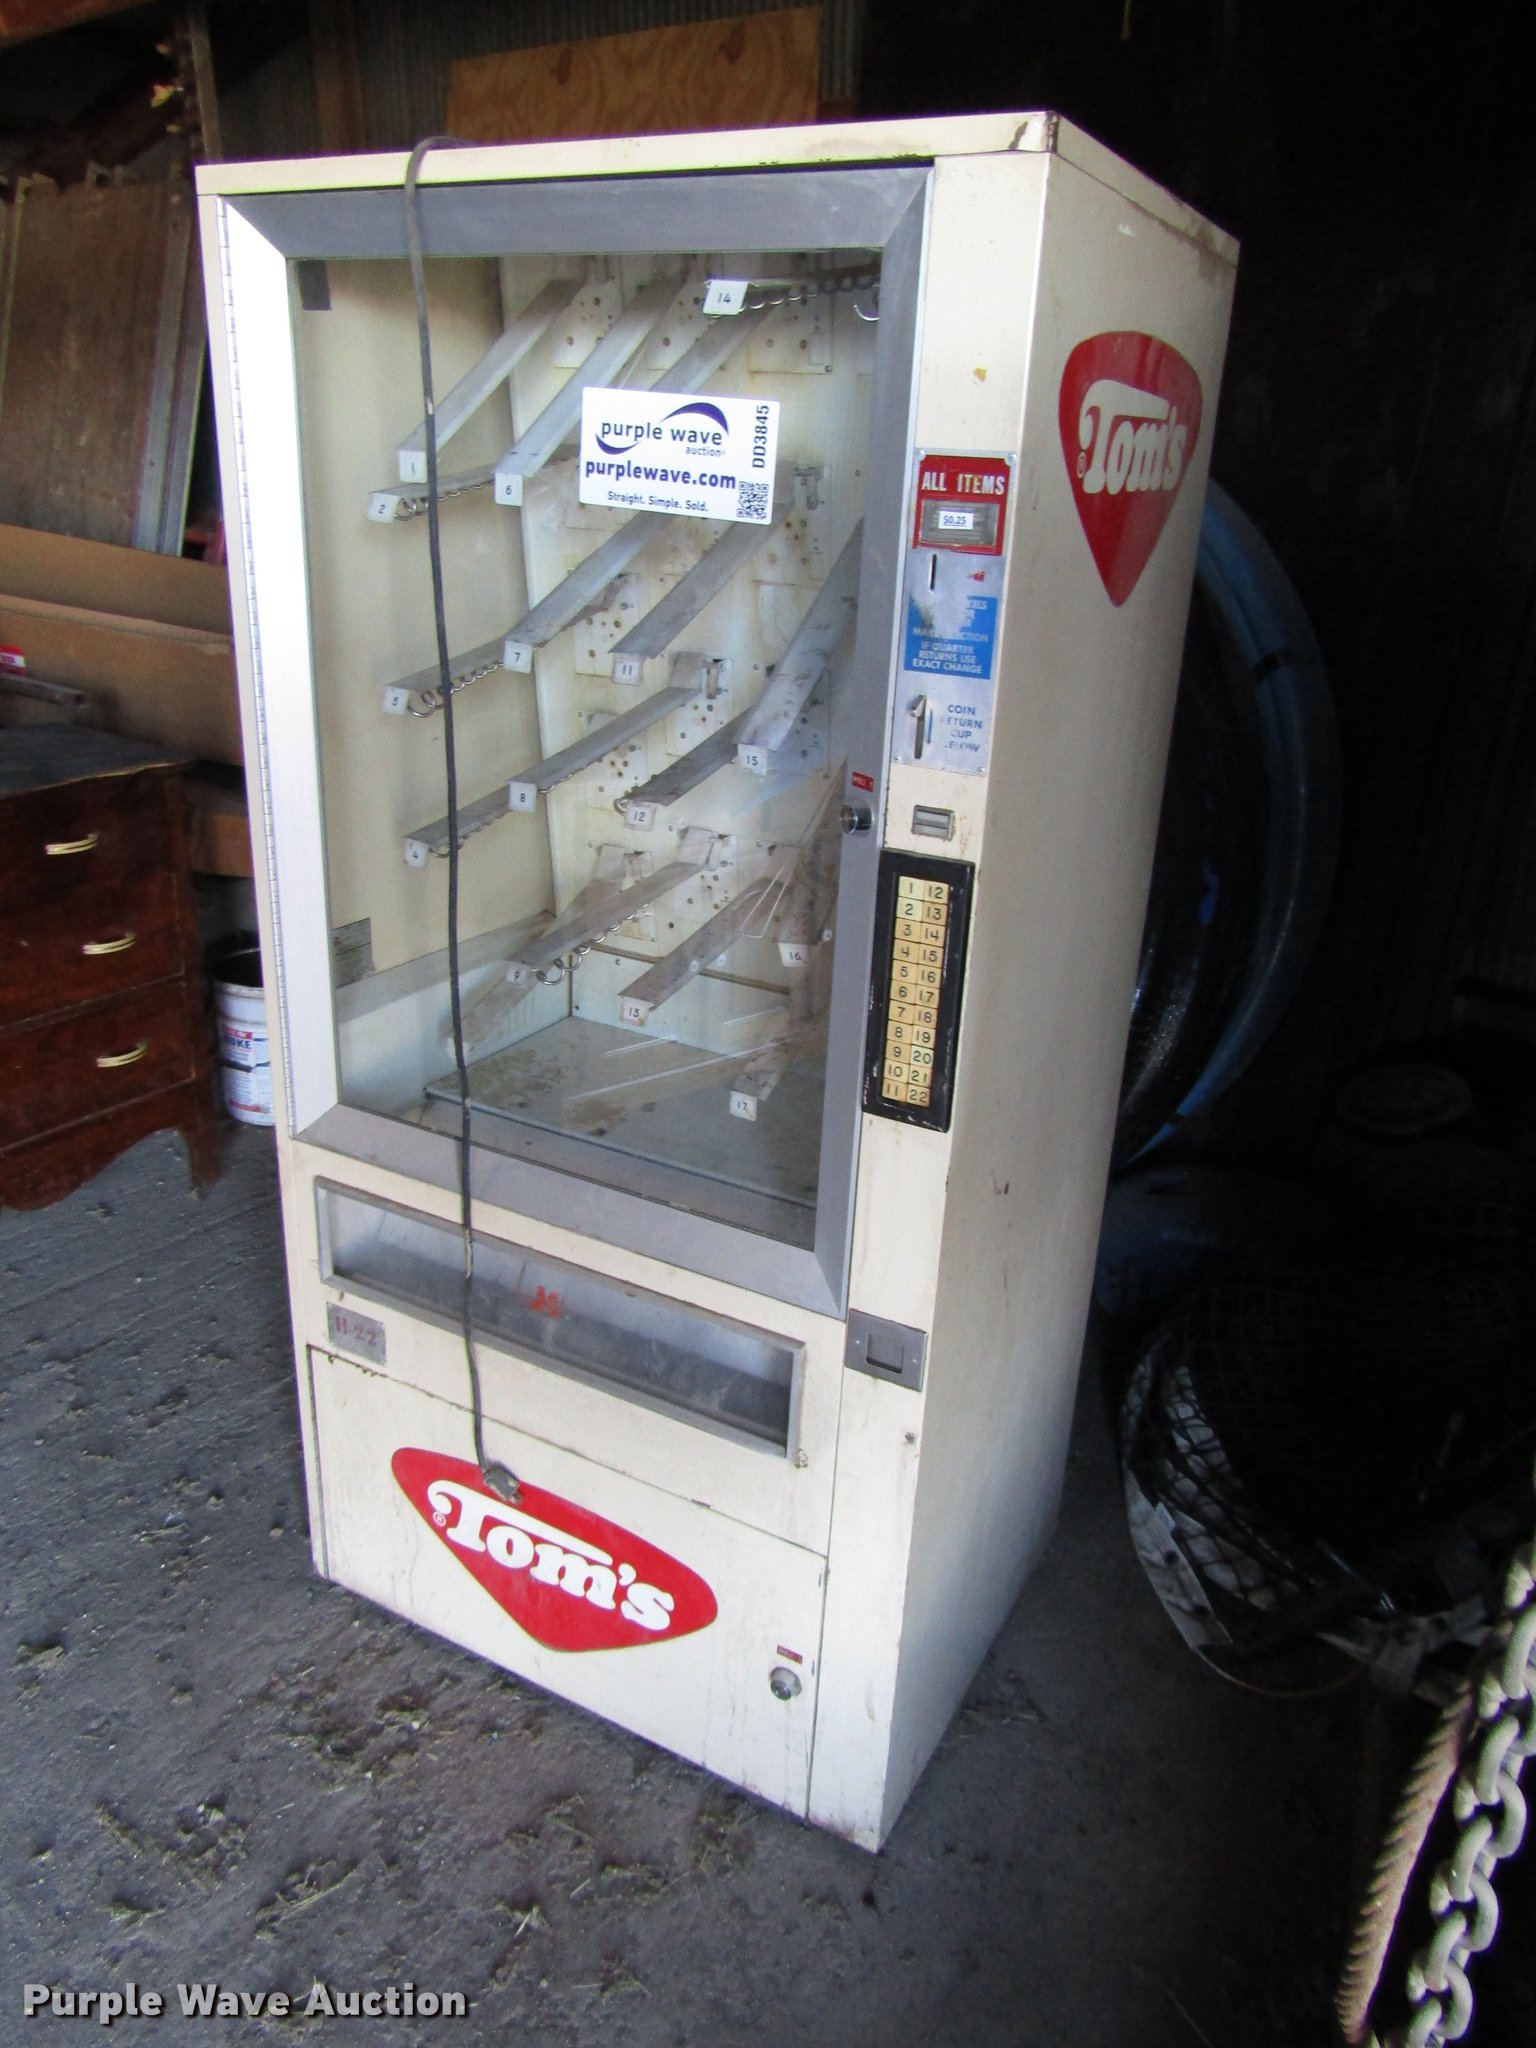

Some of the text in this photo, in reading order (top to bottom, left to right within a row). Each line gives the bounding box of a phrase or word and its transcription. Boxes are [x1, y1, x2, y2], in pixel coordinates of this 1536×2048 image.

[717, 292, 732, 304] 14
[601, 421, 723, 446] purple wave
[752, 405, 770, 469] DD3845
[1079, 378, 1188, 496] Tom's
[585, 460, 737, 490] purplewave.com
[505, 484, 513, 496] 6
[921, 471, 1006, 496] ALL ITEMS
[378, 503, 387, 515] 2
[607, 490, 709, 512] Straight. Simple. Sold.
[943, 514, 967, 526] $0.25
[931, 642, 974, 655] QUARTER
[514, 652, 521, 663] 7
[918, 649, 977, 665] RETURNS USE
[621, 664, 633, 676] 11
[912, 658, 982, 674] EXACT CHANGE
[947, 704, 976, 716] COIN
[946, 717, 983, 730] ETURN
[950, 729, 972, 740] CUP
[746, 753, 759, 767] 15
[519, 793, 527, 803] 8
[633, 811, 646, 823] 12
[909, 882, 944, 900] 1 12
[904, 903, 942, 921] 2 13
[903, 923, 940, 941] 3 14
[788, 951, 802, 961] 16
[901, 946, 938, 963] 4 15
[513, 970, 521, 981] 9
[899, 966, 937, 984] 5 16
[898, 985, 935, 1003] 6 17
[628, 1006, 641, 1018] 13
[897, 1006, 933, 1024] 7 18
[894, 1026, 931, 1043] 8 19
[892, 1046, 932, 1063] 9 20
[887, 1064, 927, 1082] 10 21
[886, 1083, 928, 1104] 11 22
[736, 1100, 749, 1111] 17
[427, 1479, 676, 1632] Tom's
